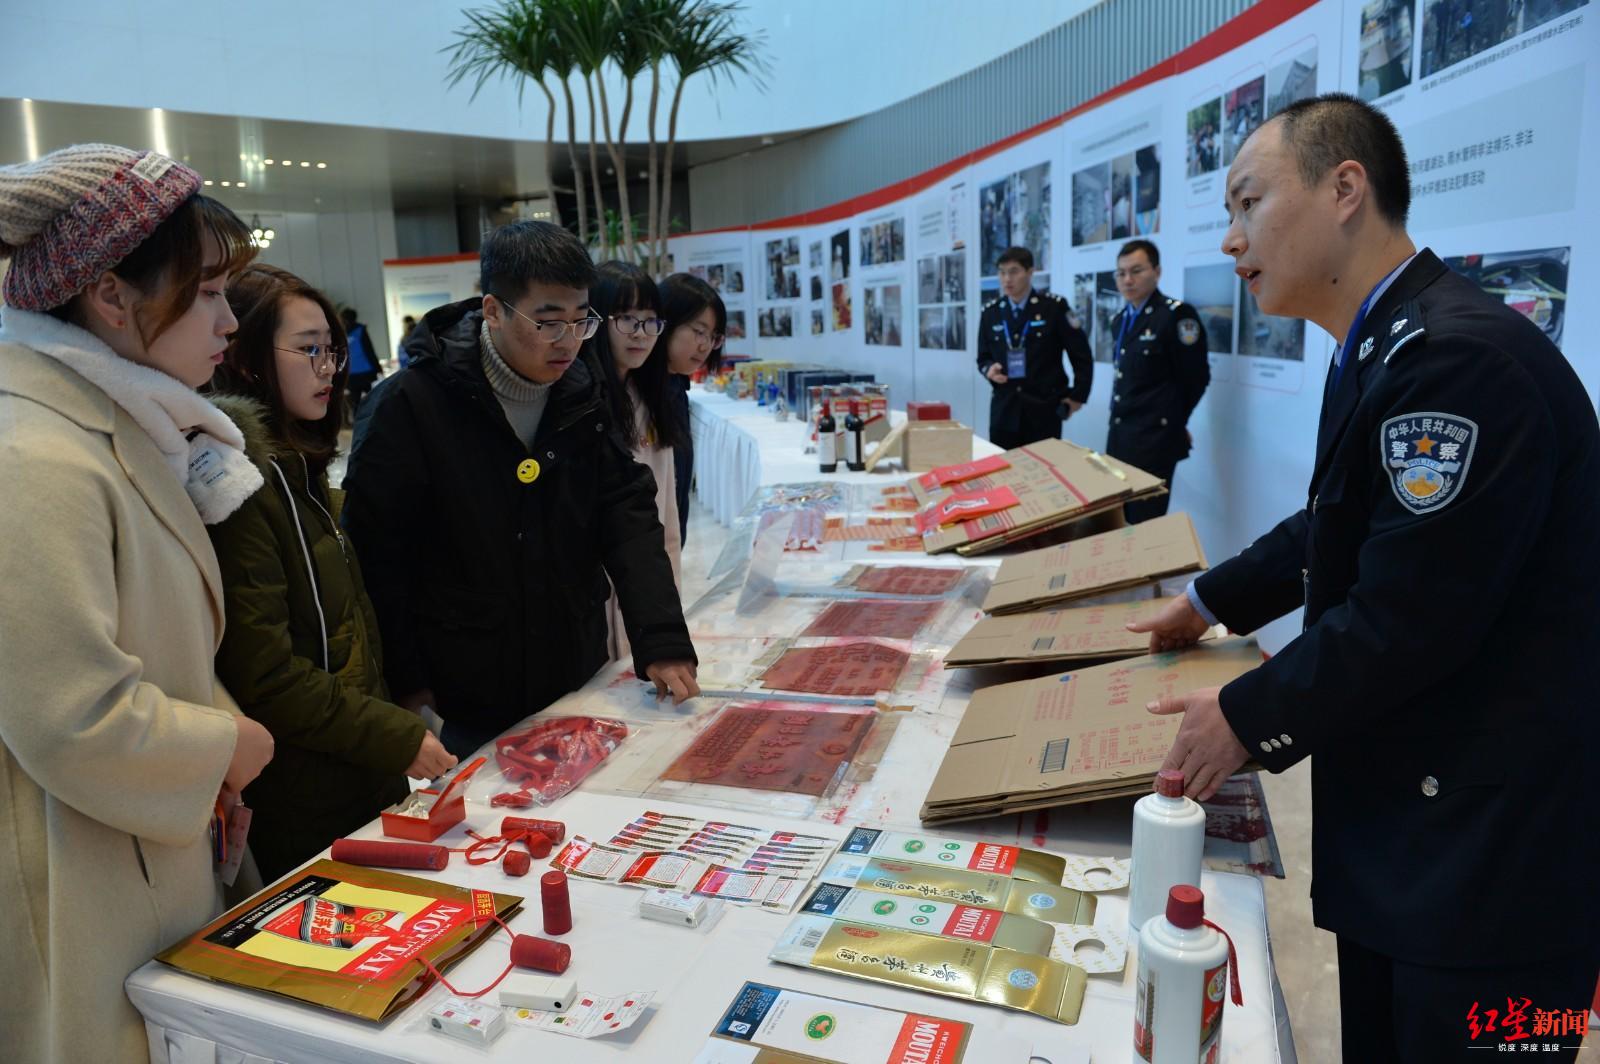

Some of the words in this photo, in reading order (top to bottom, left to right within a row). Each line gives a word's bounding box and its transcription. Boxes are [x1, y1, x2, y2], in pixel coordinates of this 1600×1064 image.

[1388, 418, 1469, 443] 中华人民共和国
[952, 907, 985, 937] MOUTAI
[355, 904, 464, 973] MOTAI
